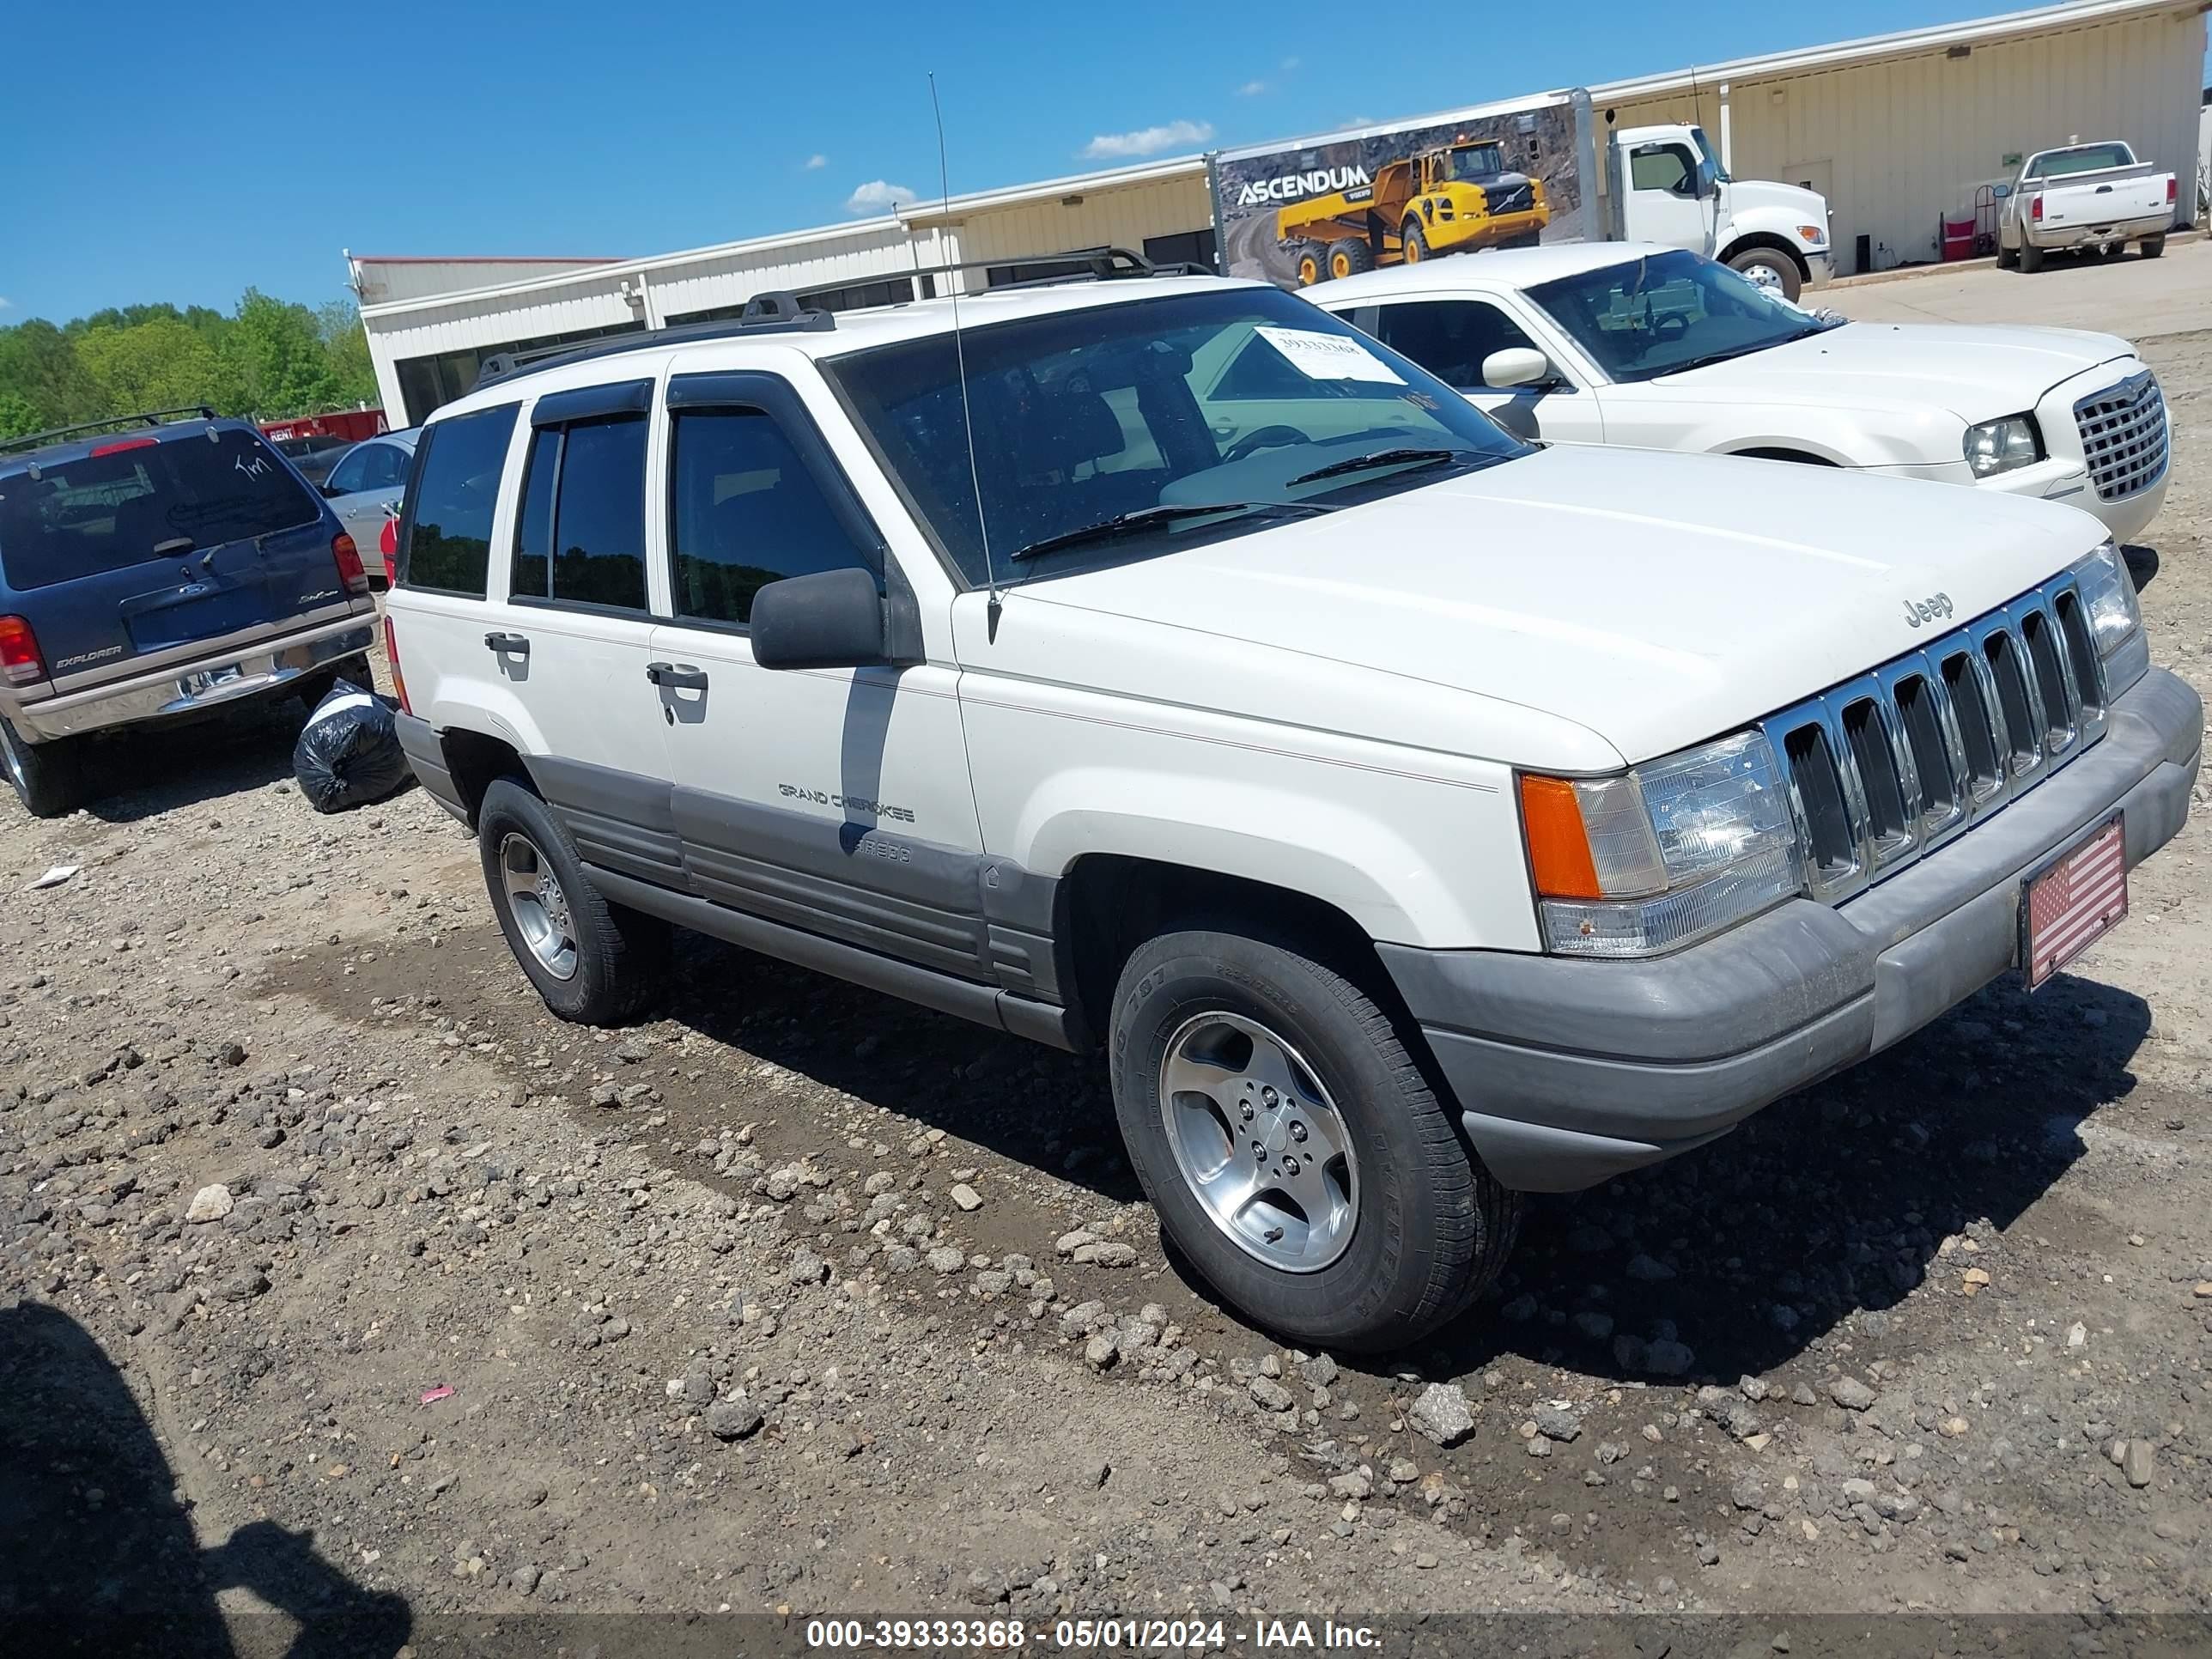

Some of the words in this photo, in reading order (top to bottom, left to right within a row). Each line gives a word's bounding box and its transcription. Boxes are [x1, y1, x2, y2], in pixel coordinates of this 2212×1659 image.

[1237, 164, 1371, 206] ASCENDUM
[270, 428, 294, 442] RENT
[1902, 592, 1954, 629] Jeep
[56, 645, 123, 669] EXPLORER
[778, 783, 828, 805] GRAND
[830, 794, 915, 823] CHEROKEE
[854, 837, 913, 864] AREDO
